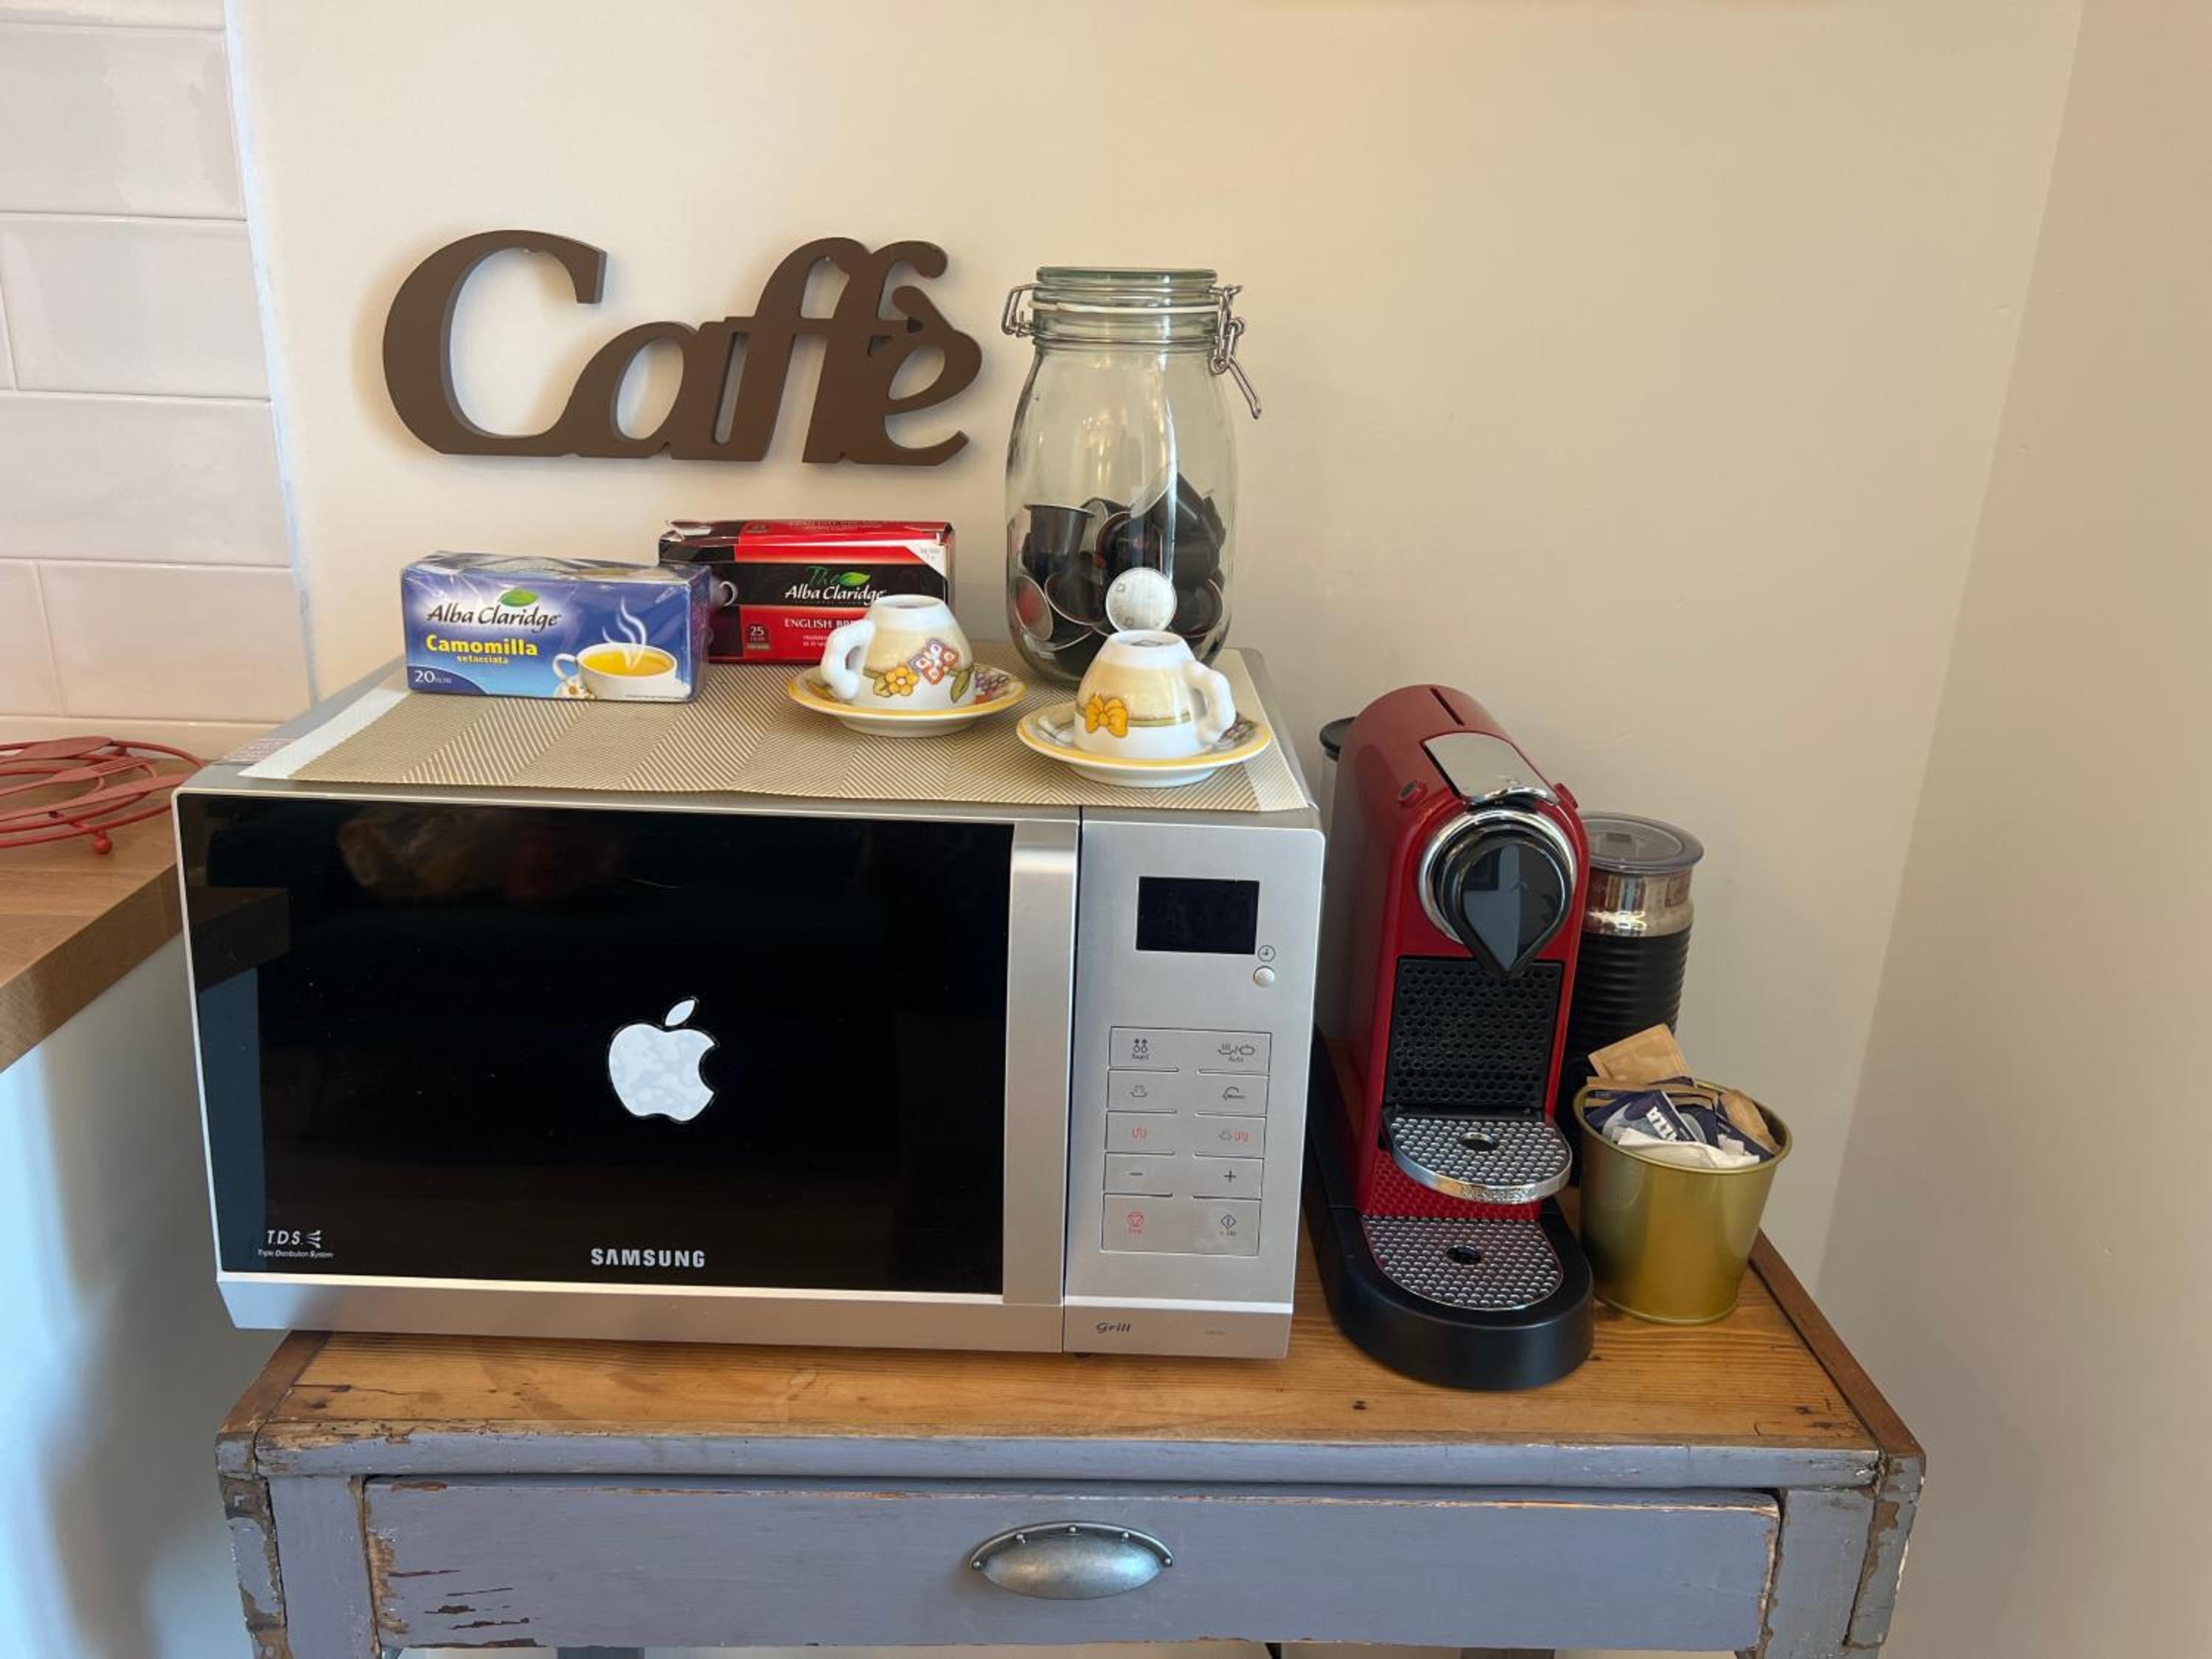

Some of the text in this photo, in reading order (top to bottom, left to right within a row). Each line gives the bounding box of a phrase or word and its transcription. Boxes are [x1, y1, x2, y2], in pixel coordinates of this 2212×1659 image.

[383, 229, 984, 467] Caffè
[785, 583, 885, 606] Alba Claridge
[426, 602, 559, 633] Alba Claridge
[785, 619, 832, 629] ENGLISH
[751, 626, 765, 636] 25
[425, 634, 538, 656] Camomilla
[456, 655, 509, 664] setacciata
[414, 669, 436, 684] 20
[590, 1248, 706, 1268] SAMSUNG
[1096, 1322, 1133, 1333] Grill
